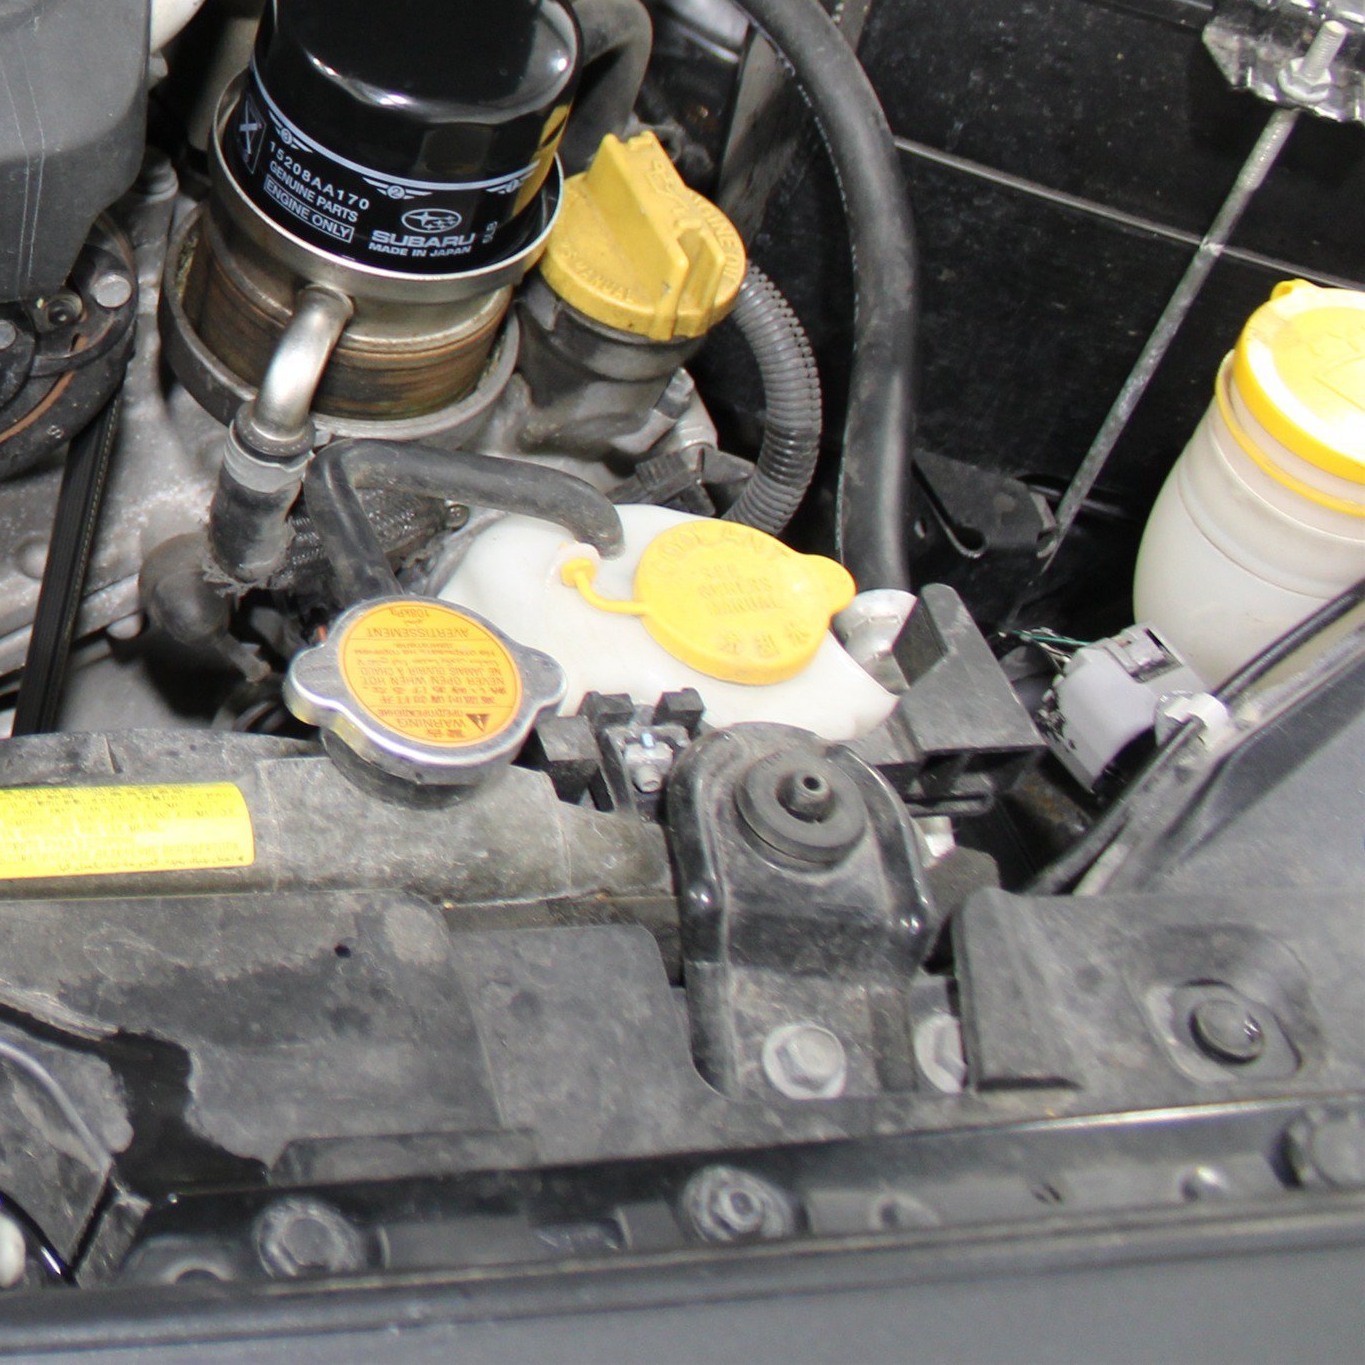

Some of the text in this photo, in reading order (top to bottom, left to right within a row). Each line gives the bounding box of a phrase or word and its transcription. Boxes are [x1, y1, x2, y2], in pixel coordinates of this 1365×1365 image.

[269, 140, 370, 210] 15208AA170
[269, 160, 359, 223] GENUINE PARTS
[266, 180, 350, 239] ENGINE ONLY
[371, 229, 476, 248] SUBARU
[368, 242, 472, 257] MADE IN JAPAN
[366, 628, 469, 638] AVERTISSEMENT
[408, 667, 445, 675] OUVRIR
[449, 667, 484, 675] JAMAIS
[390, 677, 425, 685] WHEN
[430, 677, 461, 685] OPEN
[466, 677, 505, 685] NEVER
[396, 719, 465, 728] WARNING
